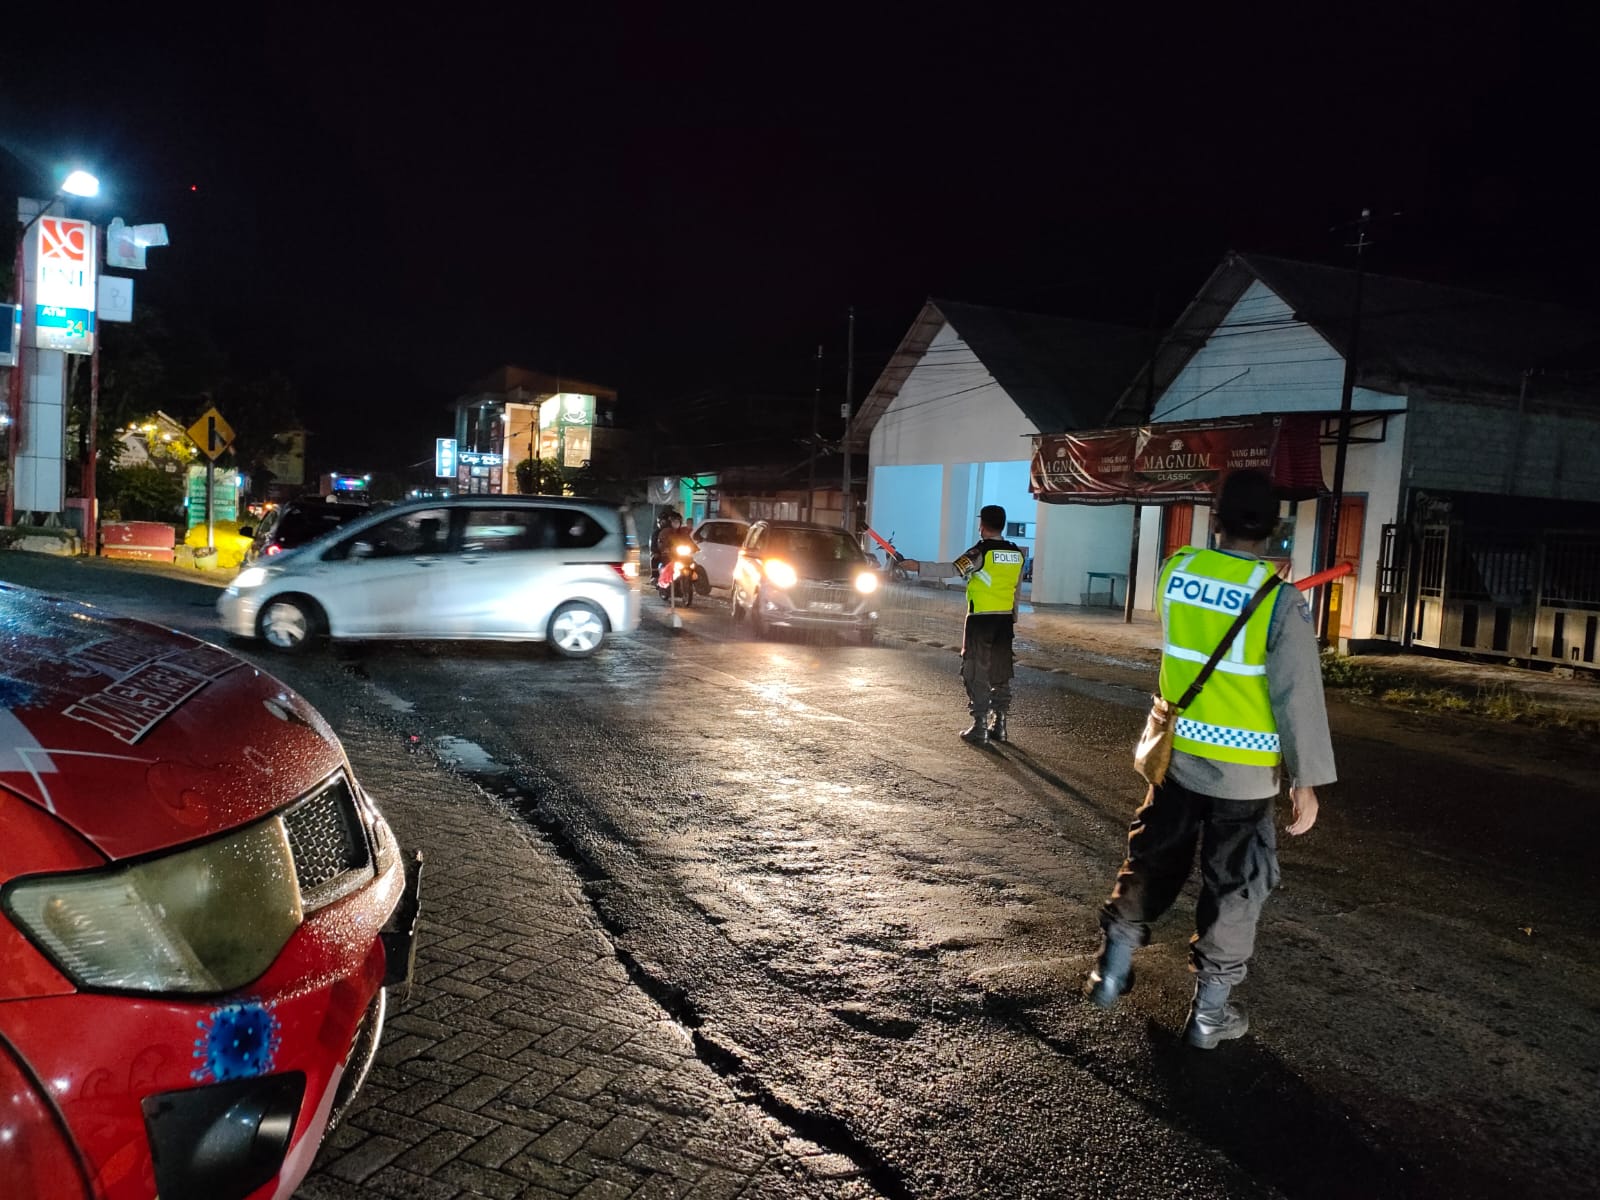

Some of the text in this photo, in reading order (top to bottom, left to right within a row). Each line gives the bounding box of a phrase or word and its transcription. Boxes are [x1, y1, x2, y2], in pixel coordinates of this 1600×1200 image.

[42, 306, 67, 317] ATM
[1142, 453, 1211, 470] MAGNUM
[1157, 473, 1192, 481] CLASSIC
[994, 552, 1020, 562] POLISI
[1166, 575, 1254, 611] POLISI
